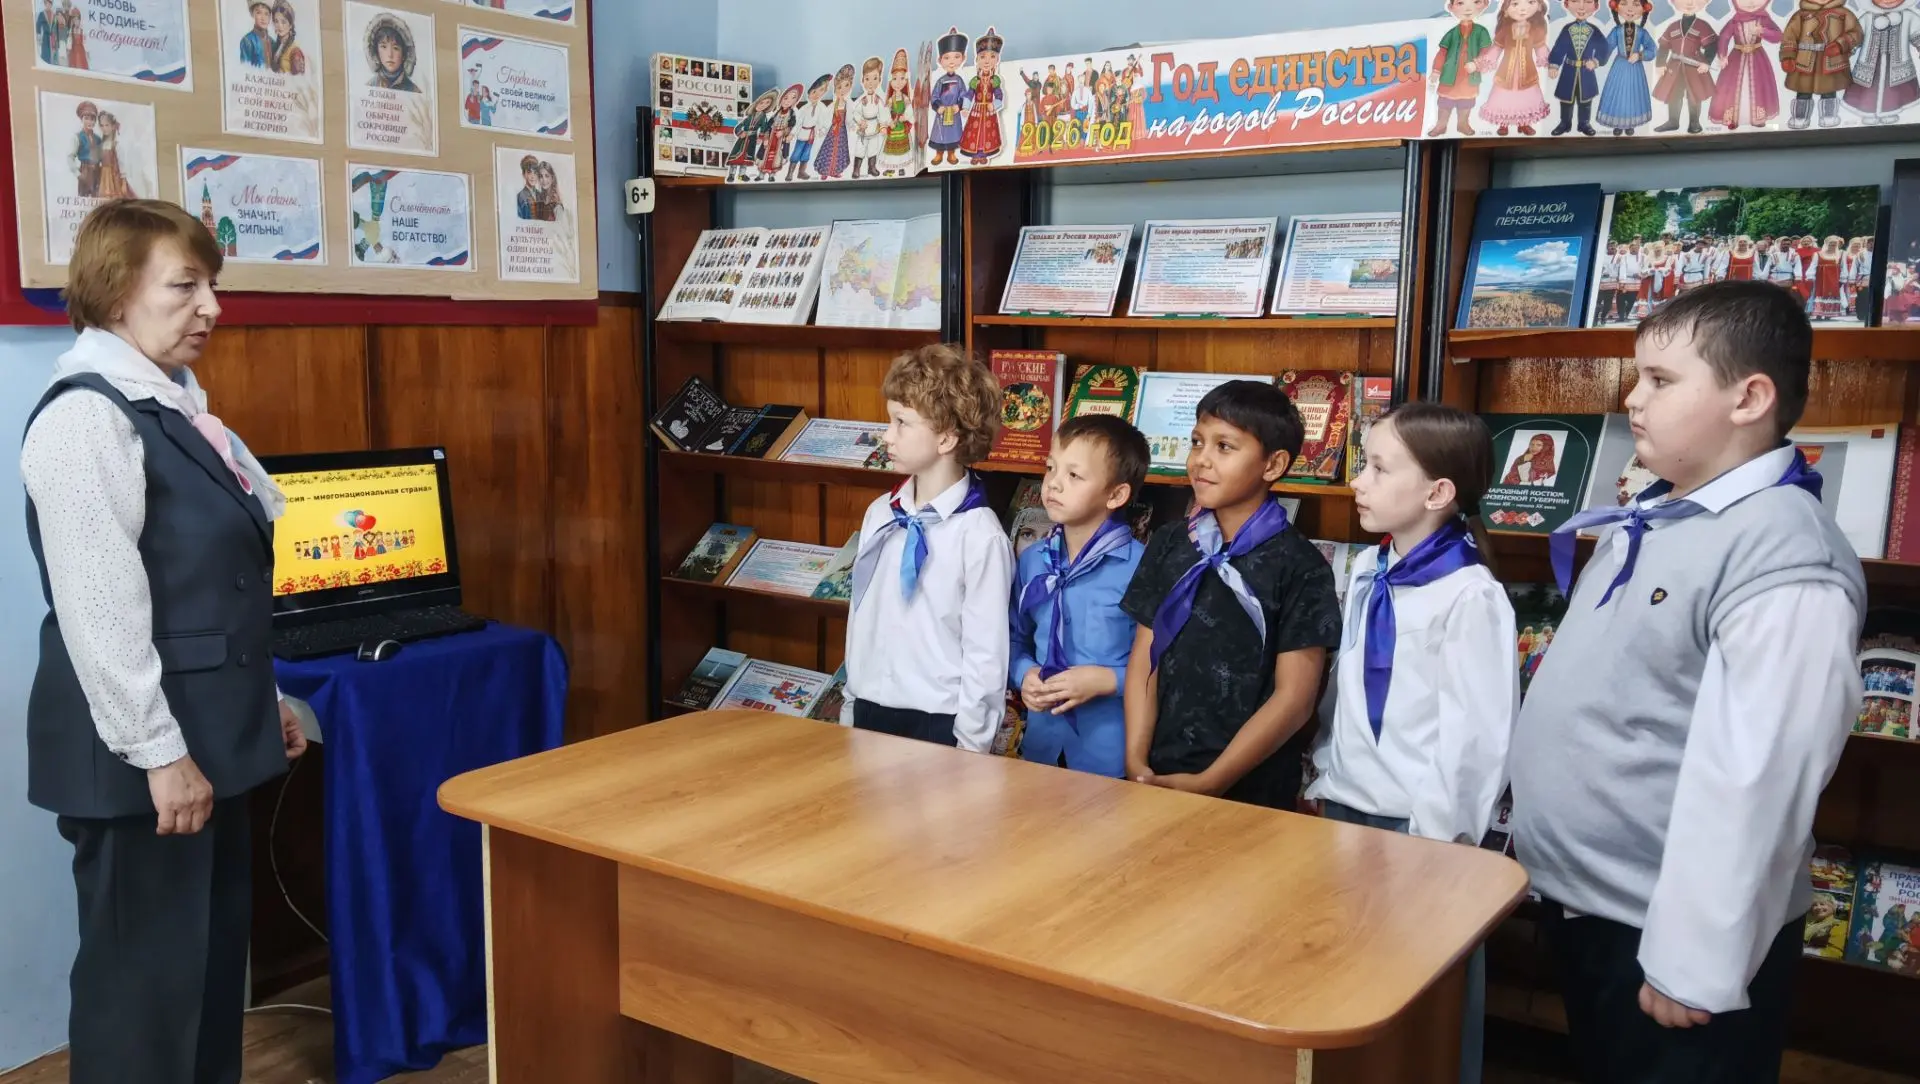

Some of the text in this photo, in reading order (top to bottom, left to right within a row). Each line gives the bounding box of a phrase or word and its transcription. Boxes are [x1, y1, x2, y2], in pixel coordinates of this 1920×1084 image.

[89, 10, 97, 22] К
[1150, 42, 1421, 105] Год единства
[676, 79, 733, 95] РОССИЯ
[244, 109, 250, 117] В
[1148, 87, 1418, 146] народов России
[1020, 119, 1081, 152] 2026
[631, 186, 649, 204] 6+
[1506, 202, 1568, 215] КРАЙ МОЙ
[391, 216, 419, 228] НАШЕ
[1495, 212, 1575, 226] ПЕНЗЕНСКИЙ
[392, 230, 447, 244] БОГАТСТВО!
[313, 488, 399, 502] многонациональная
[1529, 489, 1565, 498] КОСТЮМ
[1529, 496, 1570, 504] ГУБЕРНИИ
